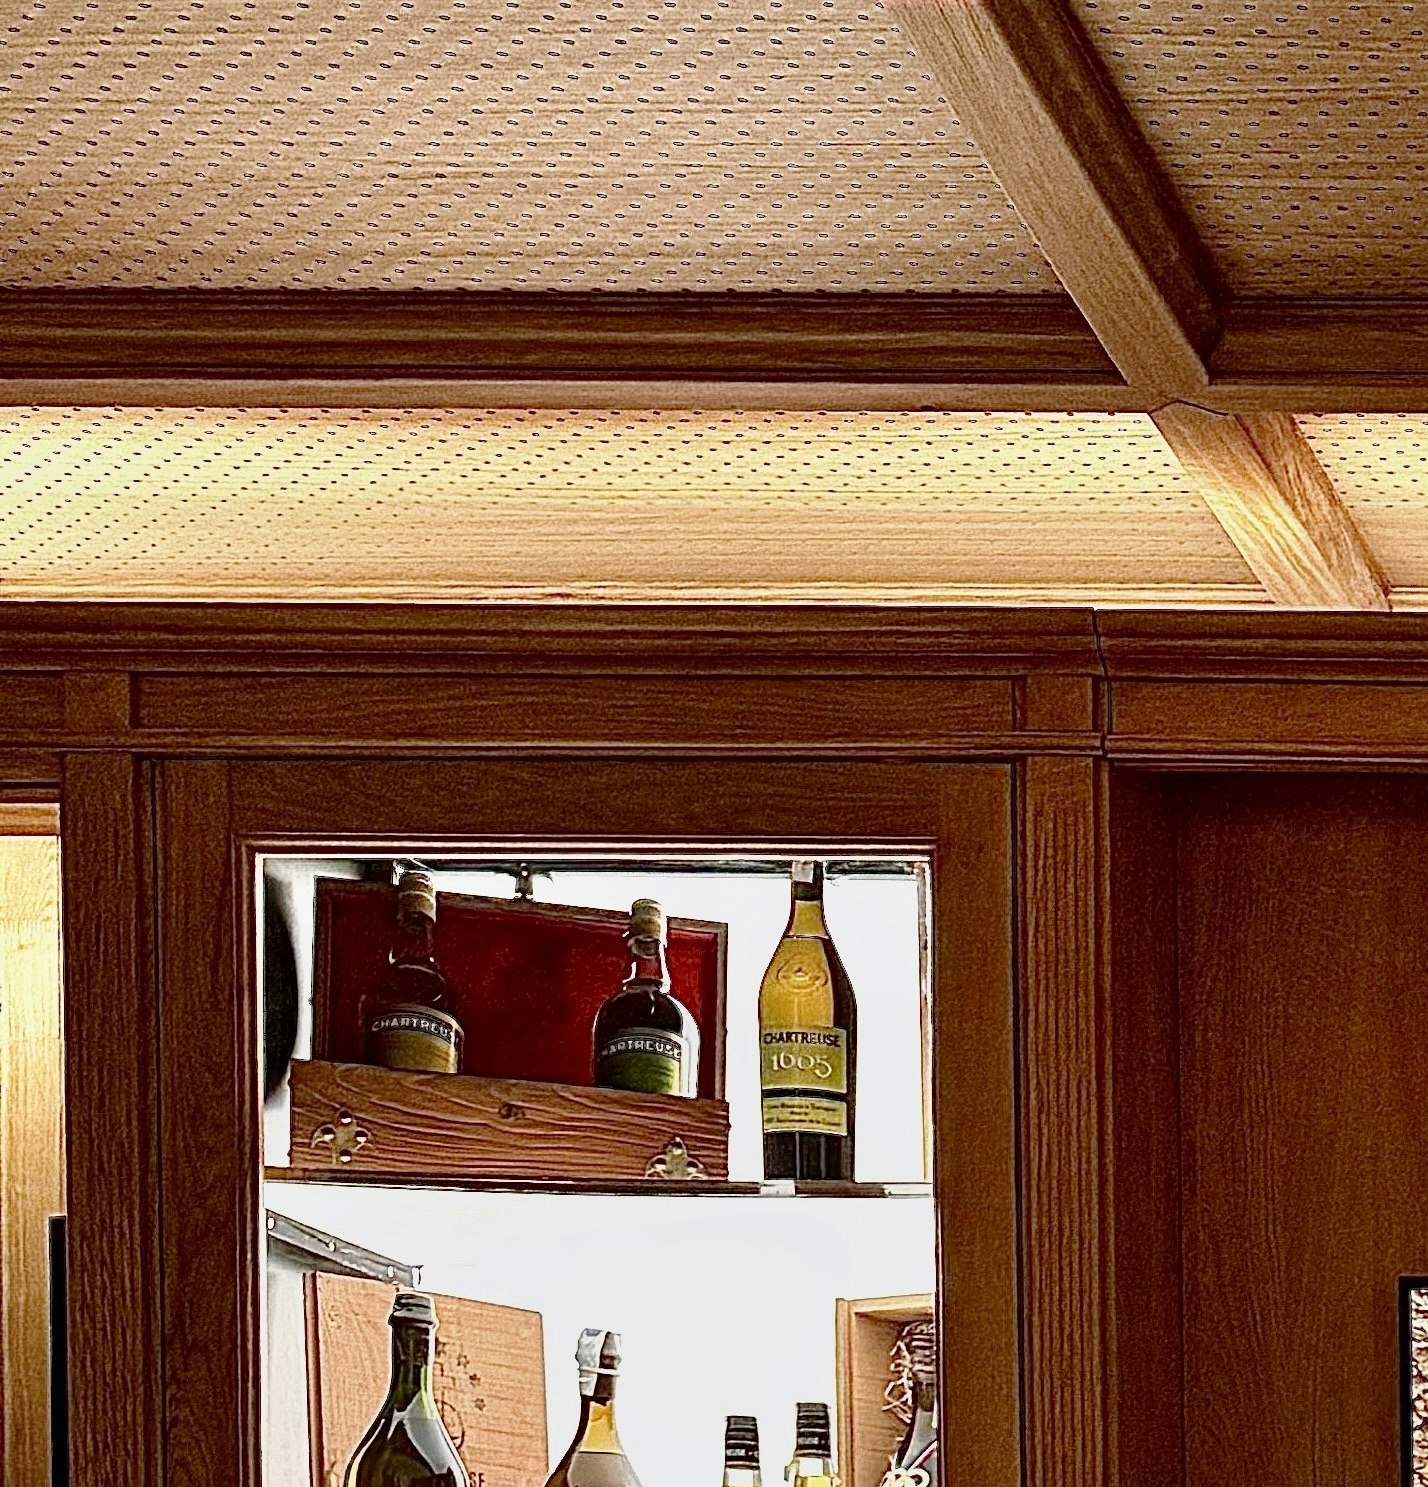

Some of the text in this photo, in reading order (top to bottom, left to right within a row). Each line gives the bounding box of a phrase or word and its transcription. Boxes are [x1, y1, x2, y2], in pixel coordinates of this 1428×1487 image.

[371, 1014, 455, 1039] CHARTREUS
[763, 1031, 842, 1048] CHARTREUSE
[771, 1051, 833, 1079] 1605
